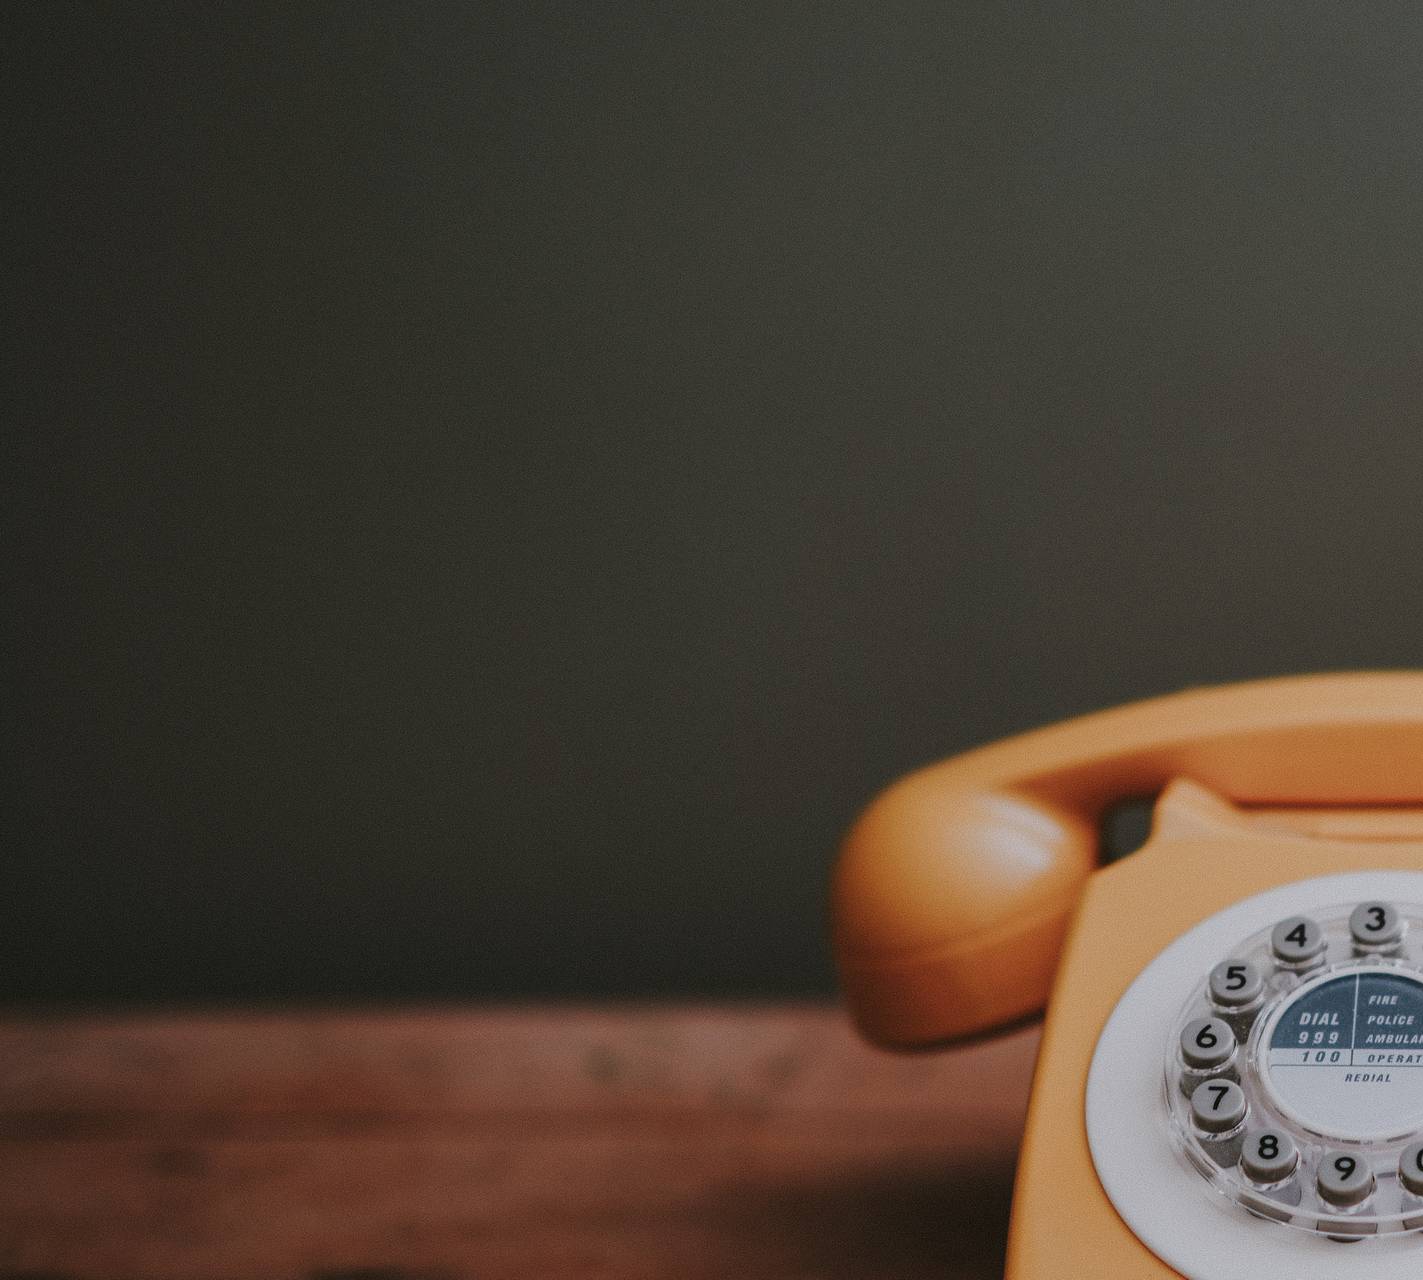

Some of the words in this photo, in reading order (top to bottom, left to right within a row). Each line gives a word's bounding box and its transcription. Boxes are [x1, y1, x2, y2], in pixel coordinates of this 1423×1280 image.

[1365, 907, 1386, 931] 3
[1284, 923, 1307, 947] 4
[1225, 966, 1247, 990] 5
[1368, 995, 1399, 1006] FIRE
[1299, 1012, 1340, 1025] DIAL
[1367, 1015, 1415, 1025] POLICE
[1195, 1024, 1218, 1049] 6
[1298, 1031, 1340, 1044] 999
[1302, 1051, 1341, 1063] 100
[1344, 1073, 1392, 1083] REDIAL
[1208, 1086, 1230, 1111] 7
[1258, 1134, 1279, 1159] 8
[1334, 1156, 1356, 1181] 9
